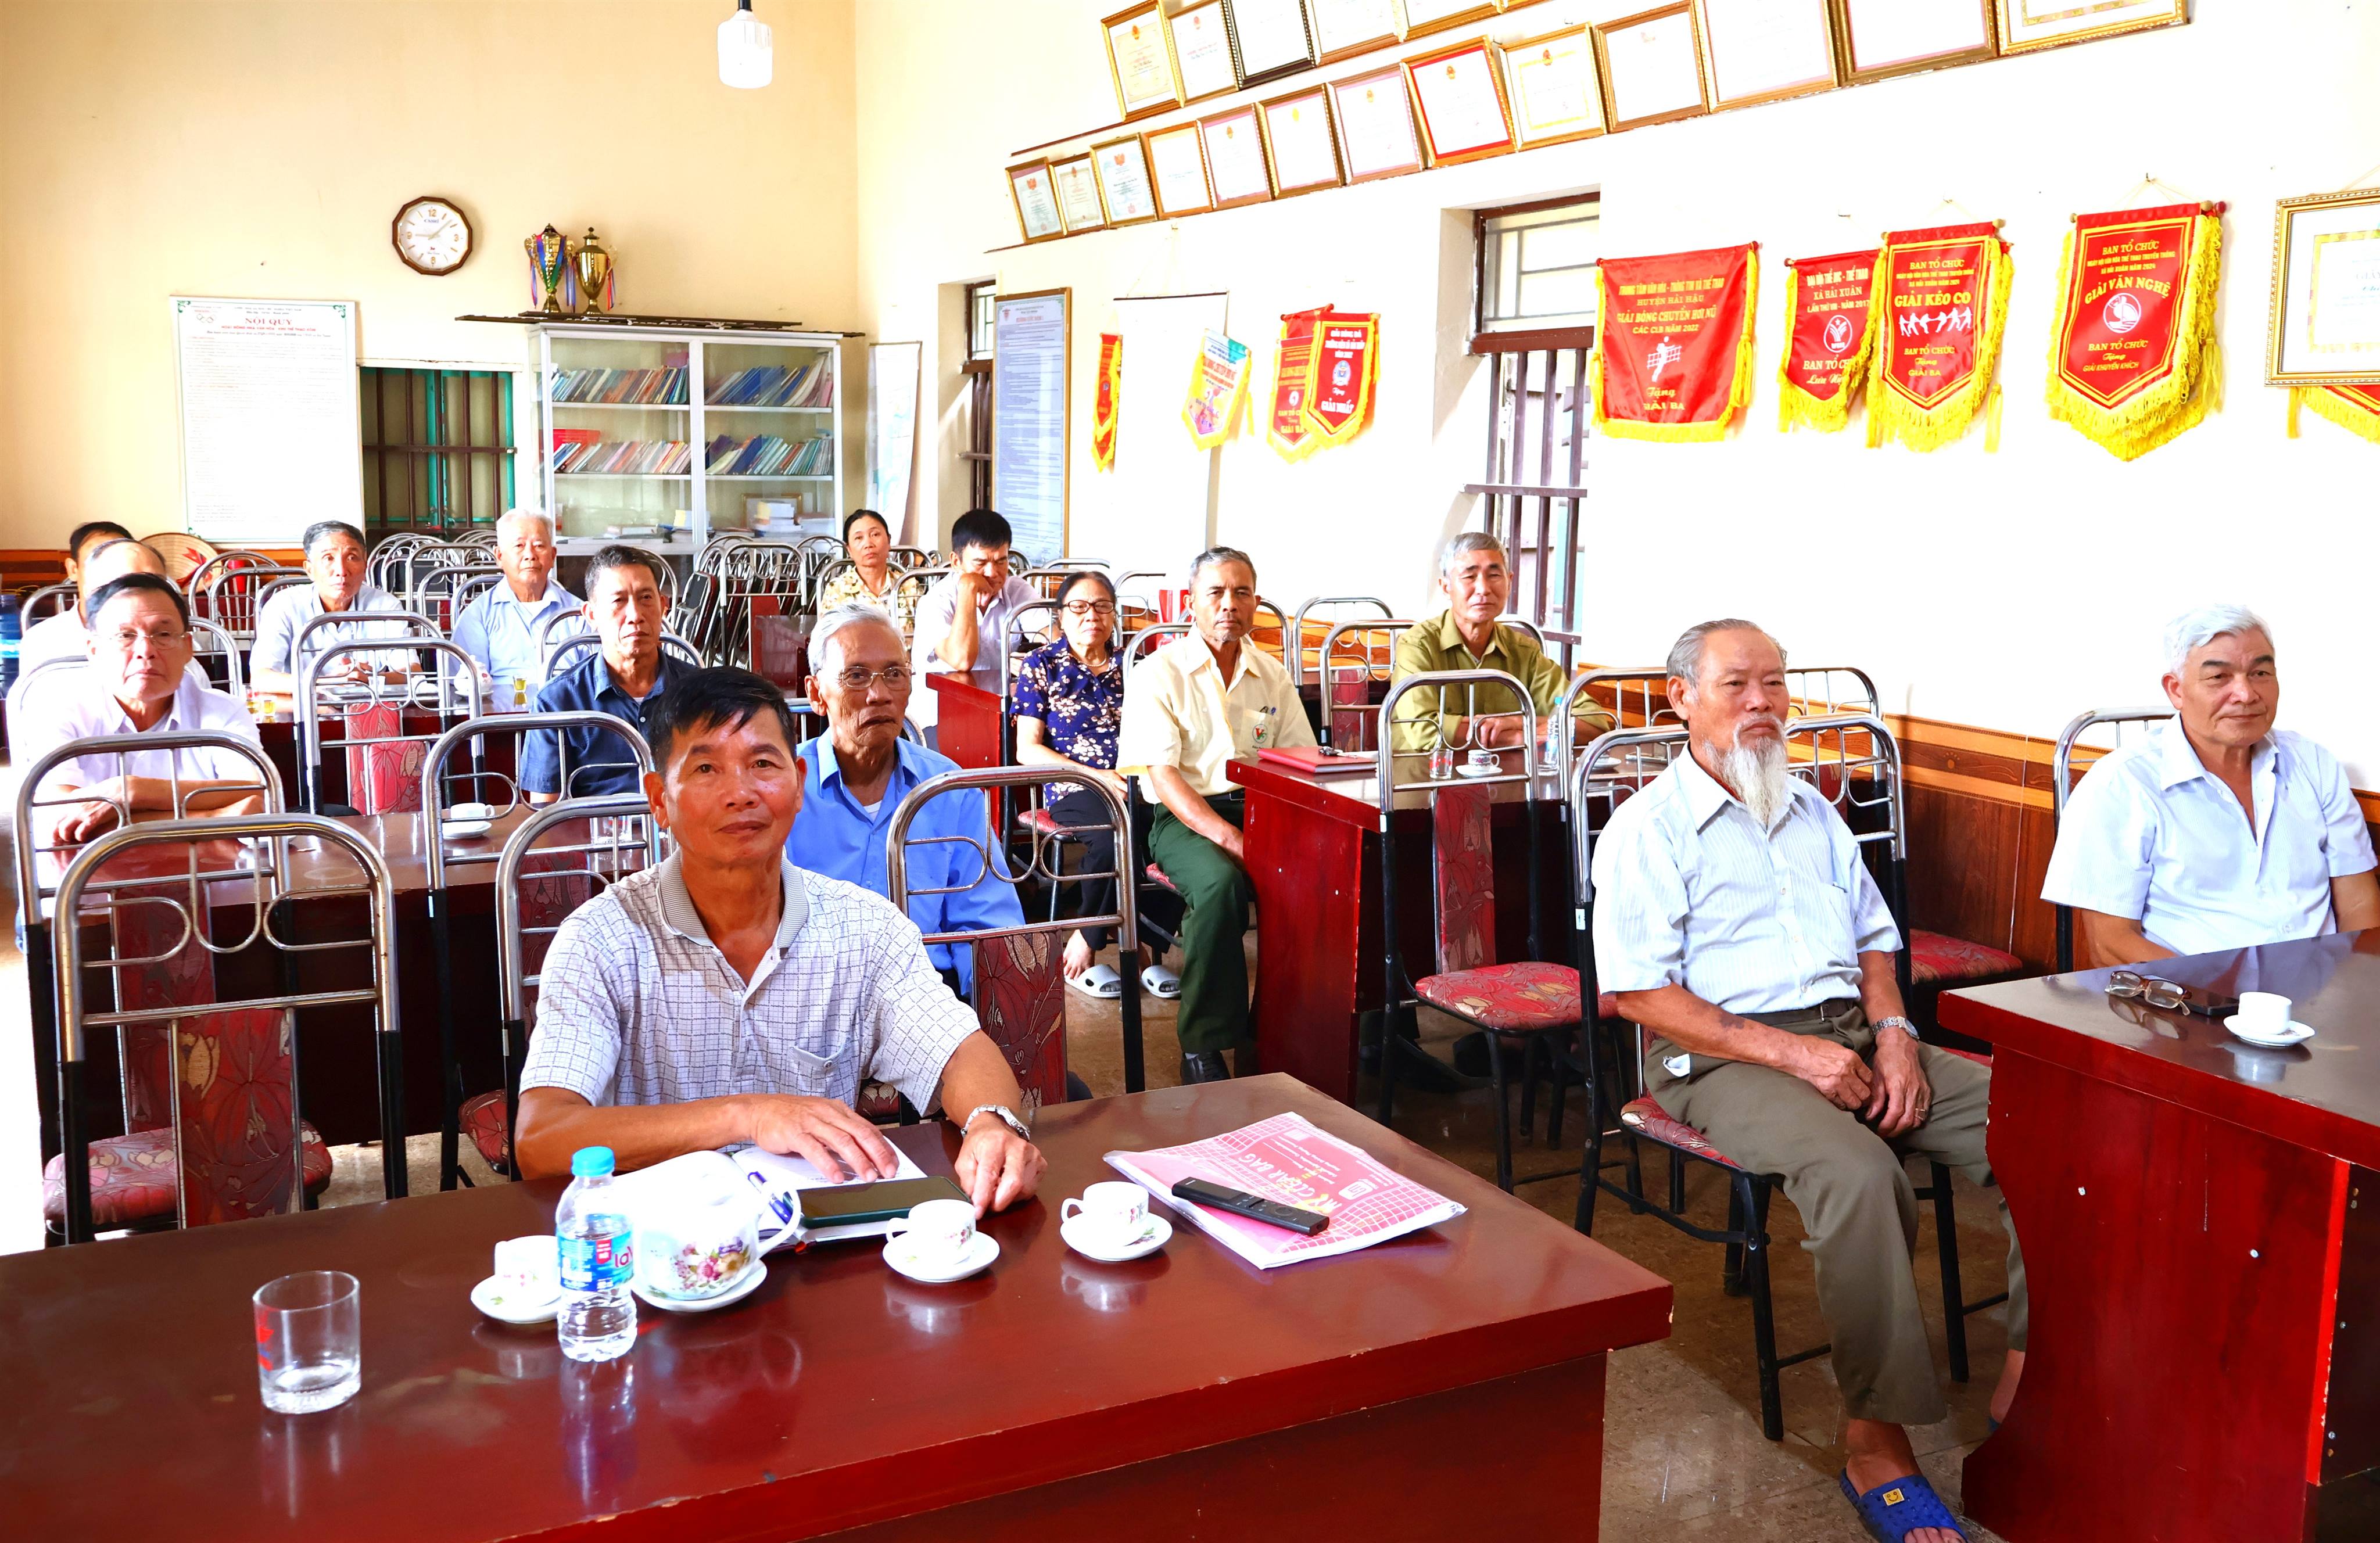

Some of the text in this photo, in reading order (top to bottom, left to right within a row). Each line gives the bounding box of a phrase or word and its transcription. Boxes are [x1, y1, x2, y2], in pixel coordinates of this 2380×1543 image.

[428, 209, 437, 217] 12
[2102, 239, 2160, 255] BAN TỔ CHỨC
[1910, 256, 1965, 270] BAN TỔ CHỨC
[1839, 285, 1862, 297] XUÂN
[2085, 274, 2171, 304] GIẢI VĂN NGHỆ
[1637, 294, 1704, 306] HUYỆN HẢI HẬU
[1894, 290, 1972, 307] GIẢI KÉO CO
[1635, 310, 1657, 322] BÓNG
[1633, 325, 1649, 333] CÁC
[1665, 324, 1682, 333] NĂM
[1683, 324, 1699, 332] 2022
[1919, 343, 1930, 354] TỔ
[1931, 345, 1955, 354] CHỨC
[2088, 338, 2148, 351] BAN TỔ CHỨC
[1802, 360, 1824, 369] BAN
[1825, 354, 1839, 369] TỔ
[1908, 368, 1927, 376] GIẢI
[1647, 386, 1676, 399] Tặng
[1670, 402, 1685, 410] BA
[1239, 1153, 1274, 1178] BAG
